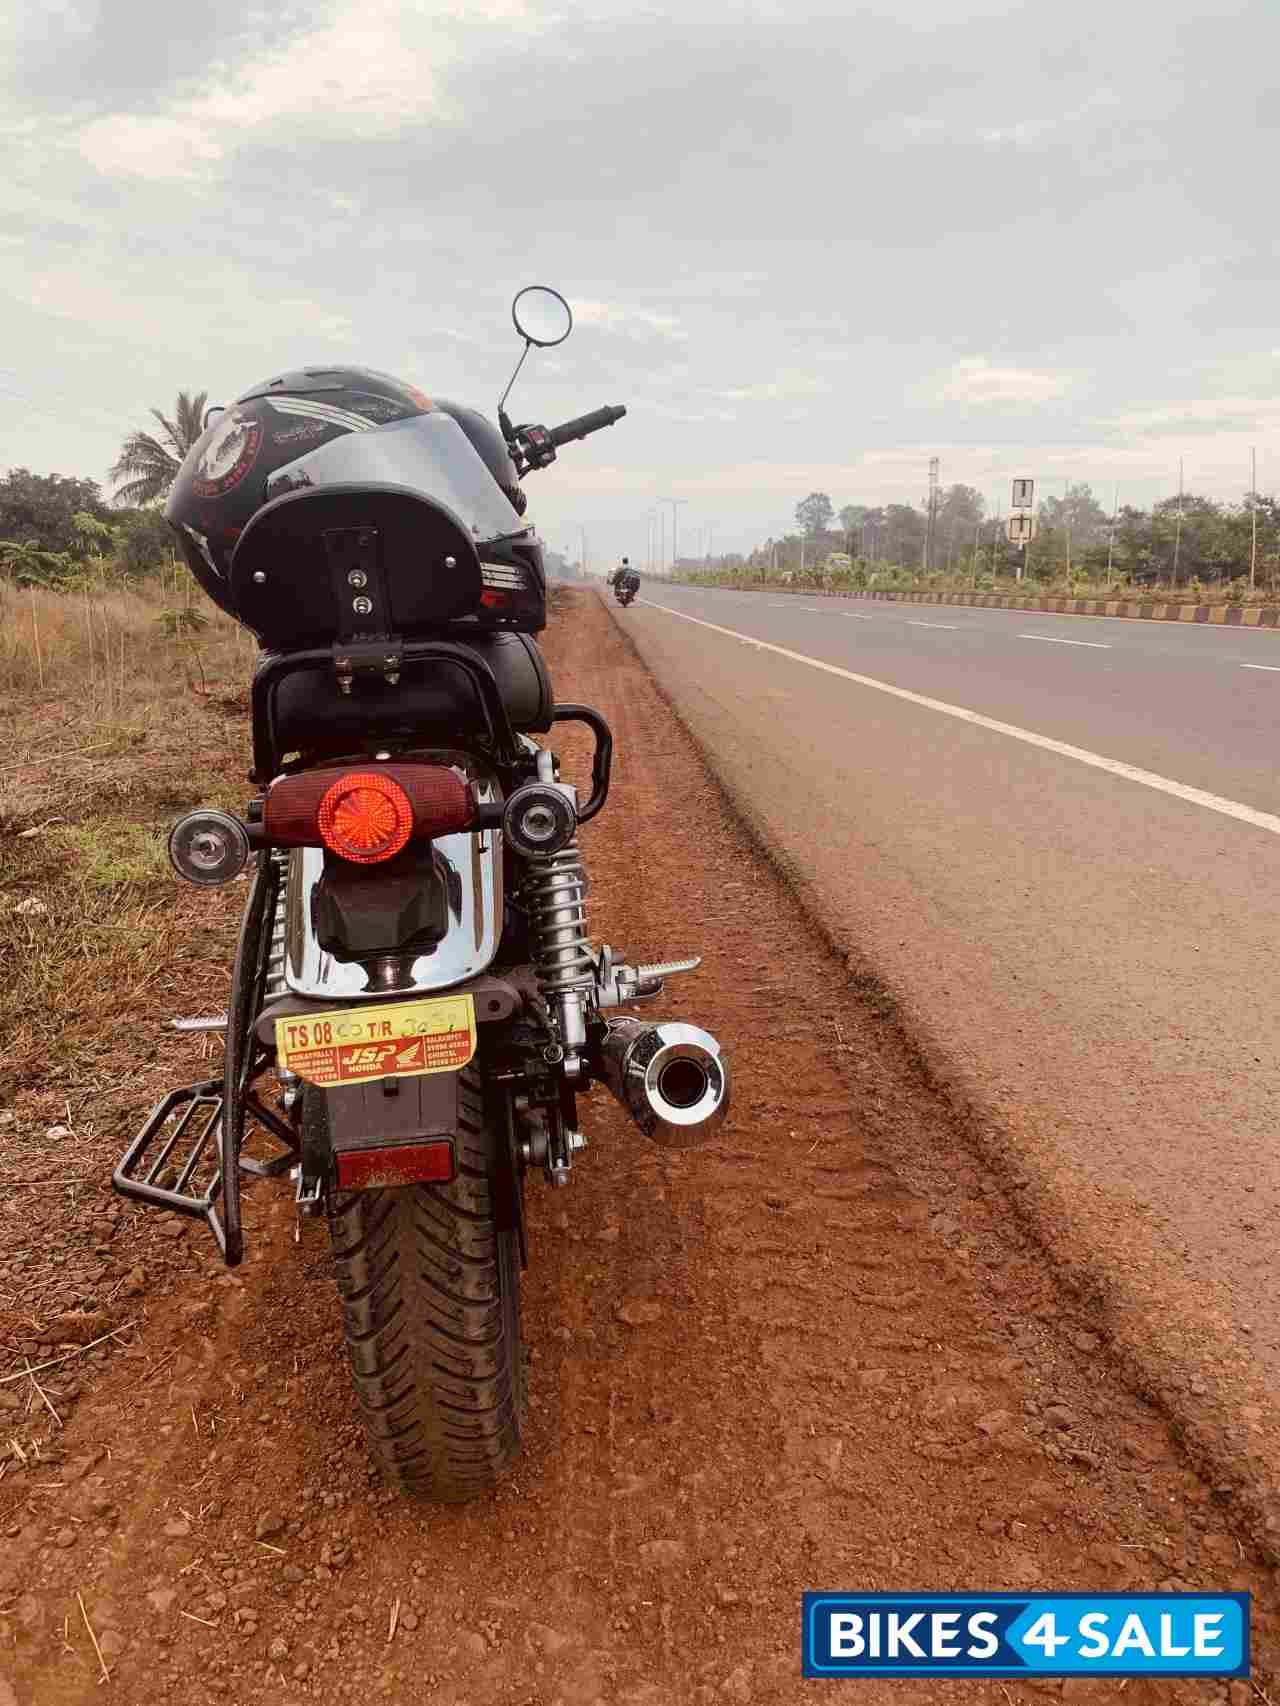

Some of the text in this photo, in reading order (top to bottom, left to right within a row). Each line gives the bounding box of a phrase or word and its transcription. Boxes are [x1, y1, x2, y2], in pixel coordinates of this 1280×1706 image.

[287, 1024, 307, 1048] TS
[314, 1021, 333, 1045] 08
[367, 1021, 393, 1038] T/R
[342, 1044, 397, 1065] JSP
[348, 1063, 383, 1073] HONDA
